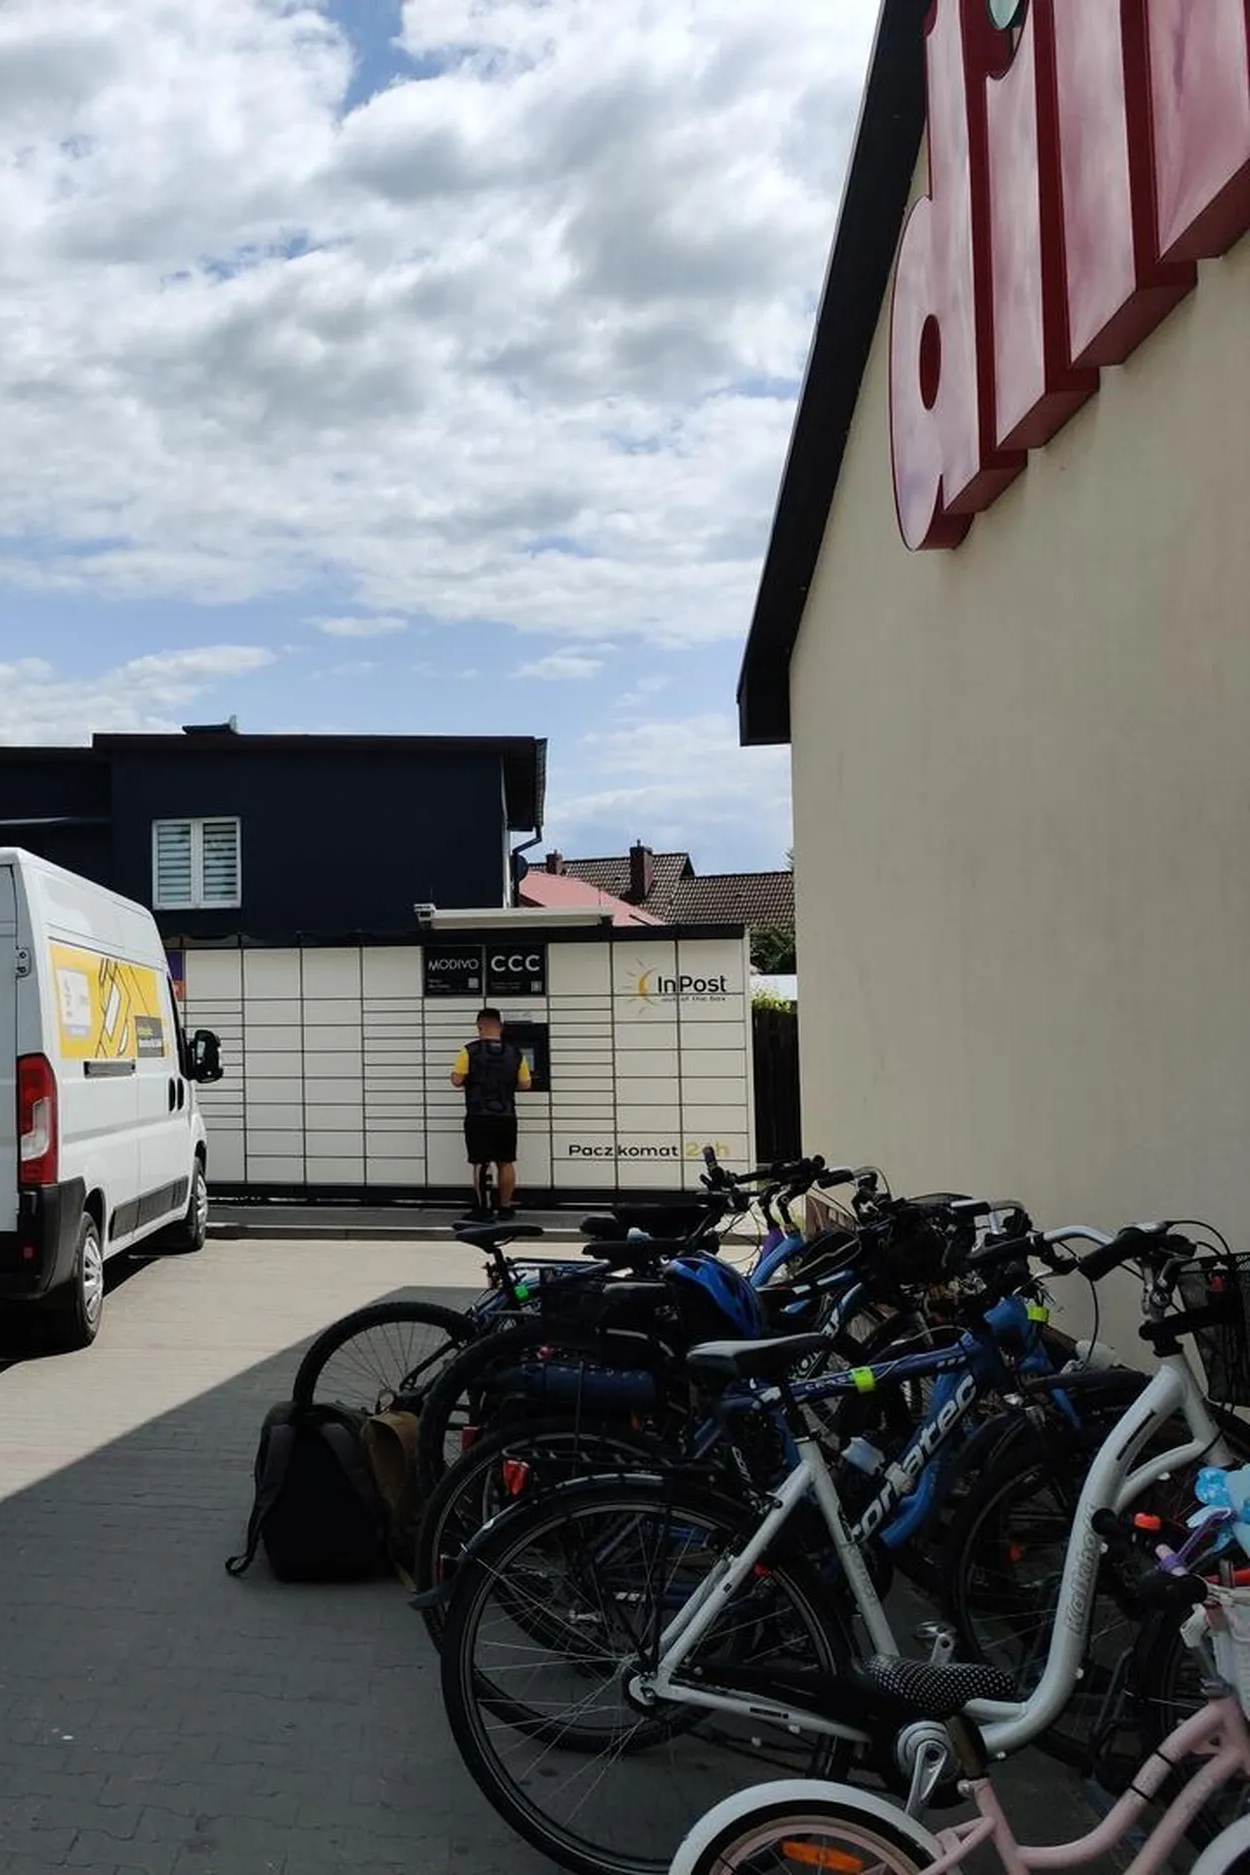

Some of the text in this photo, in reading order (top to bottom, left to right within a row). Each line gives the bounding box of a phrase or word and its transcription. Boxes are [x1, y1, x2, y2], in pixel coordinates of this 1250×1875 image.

[428, 958, 479, 971] MODIVO
[491, 955, 540, 971] CCC
[658, 975, 727, 993] InPost
[568, 1142, 730, 1157] Paczkomat 2h
